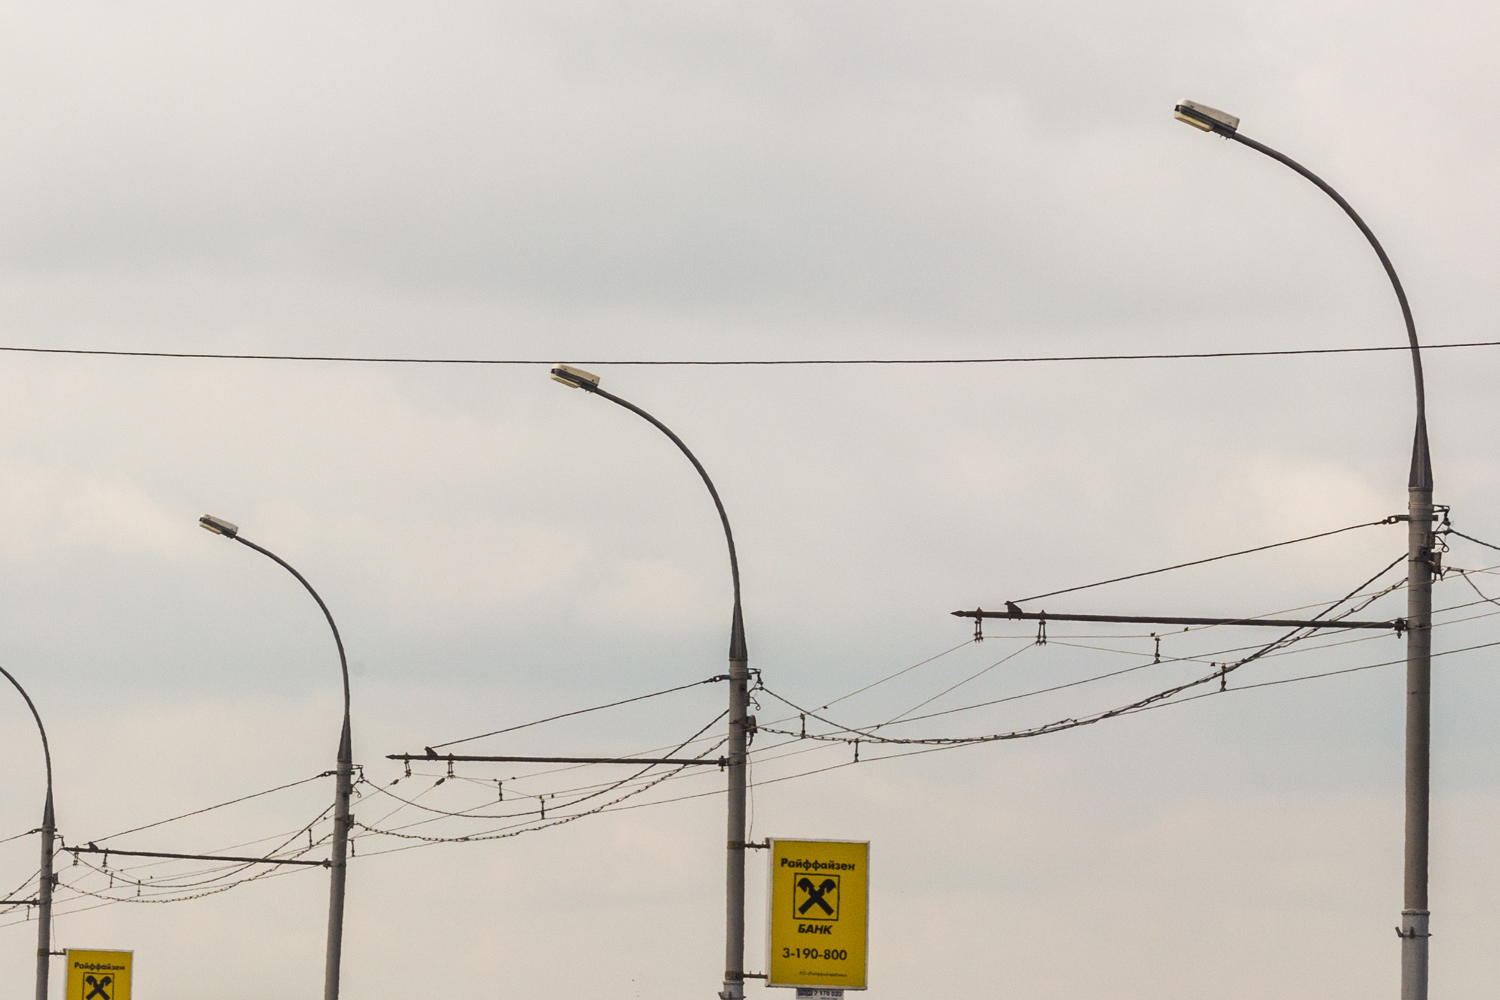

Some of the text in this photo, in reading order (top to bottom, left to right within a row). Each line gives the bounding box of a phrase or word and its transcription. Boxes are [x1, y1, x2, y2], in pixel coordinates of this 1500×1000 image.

[780, 858, 856, 871] Райффайзен
[797, 924, 834, 935] БАНК
[782, 947, 848, 961] 3-190-800
[73, 961, 126, 972] Райффайзен
